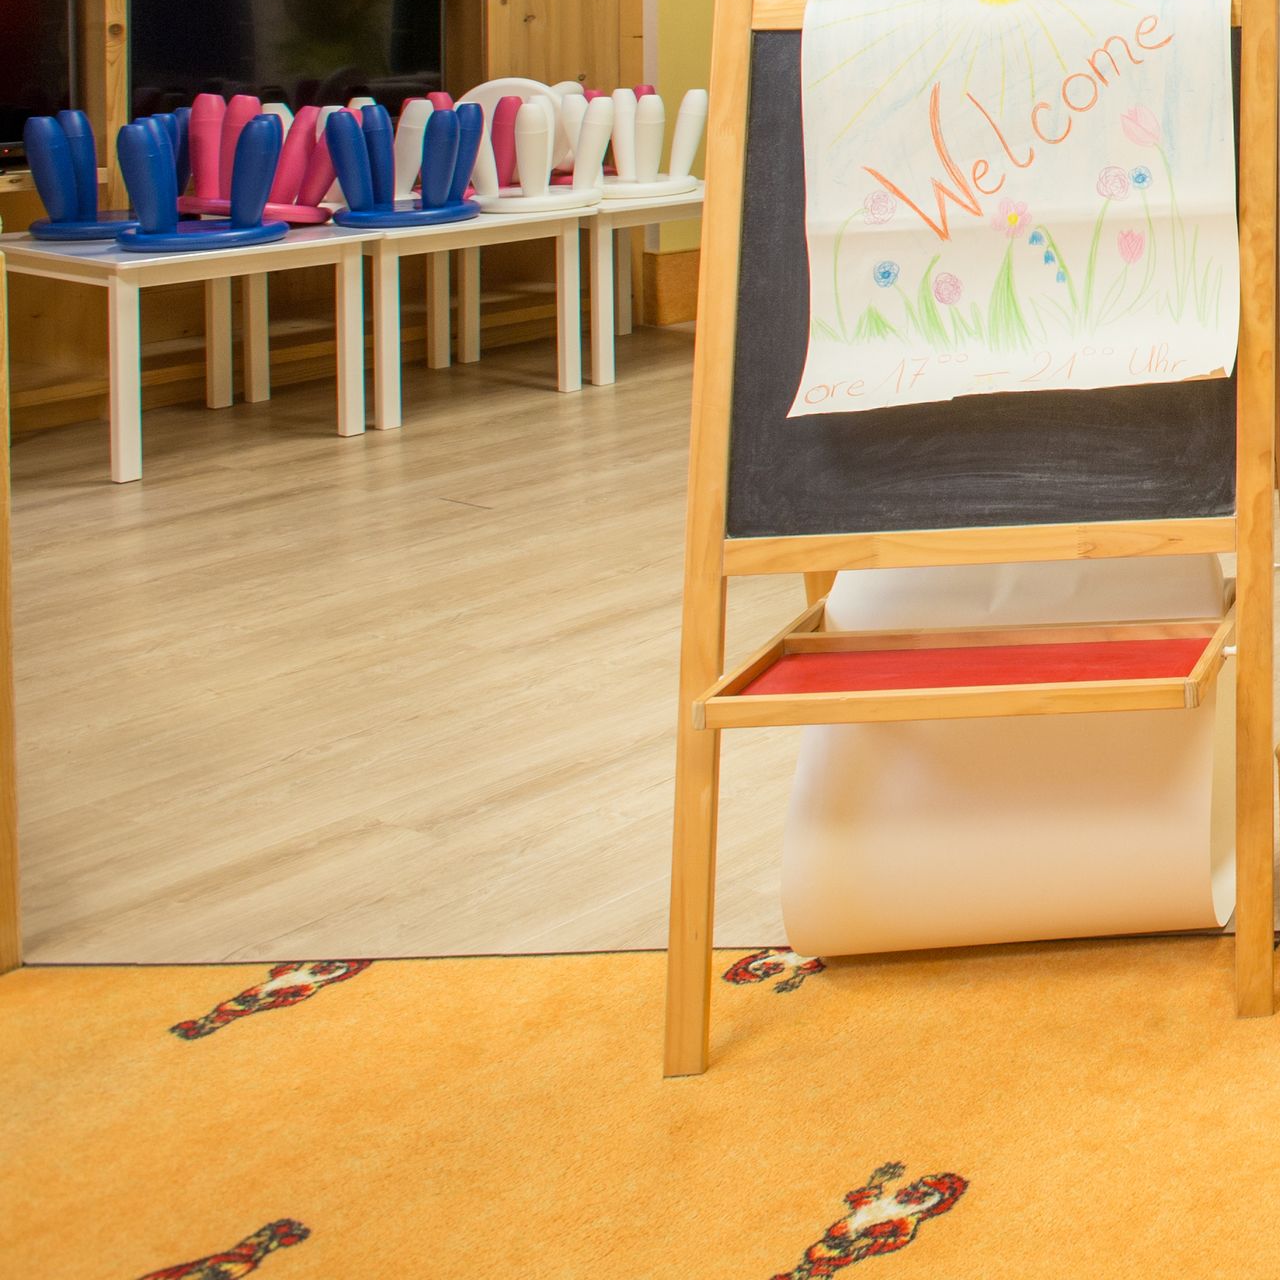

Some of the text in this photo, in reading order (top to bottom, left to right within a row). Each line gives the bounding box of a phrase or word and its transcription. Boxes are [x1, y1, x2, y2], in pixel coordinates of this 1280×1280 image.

[861, 13, 1175, 241] Welcome
[804, 379, 866, 406] ore
[1129, 342, 1189, 377] Uhr
